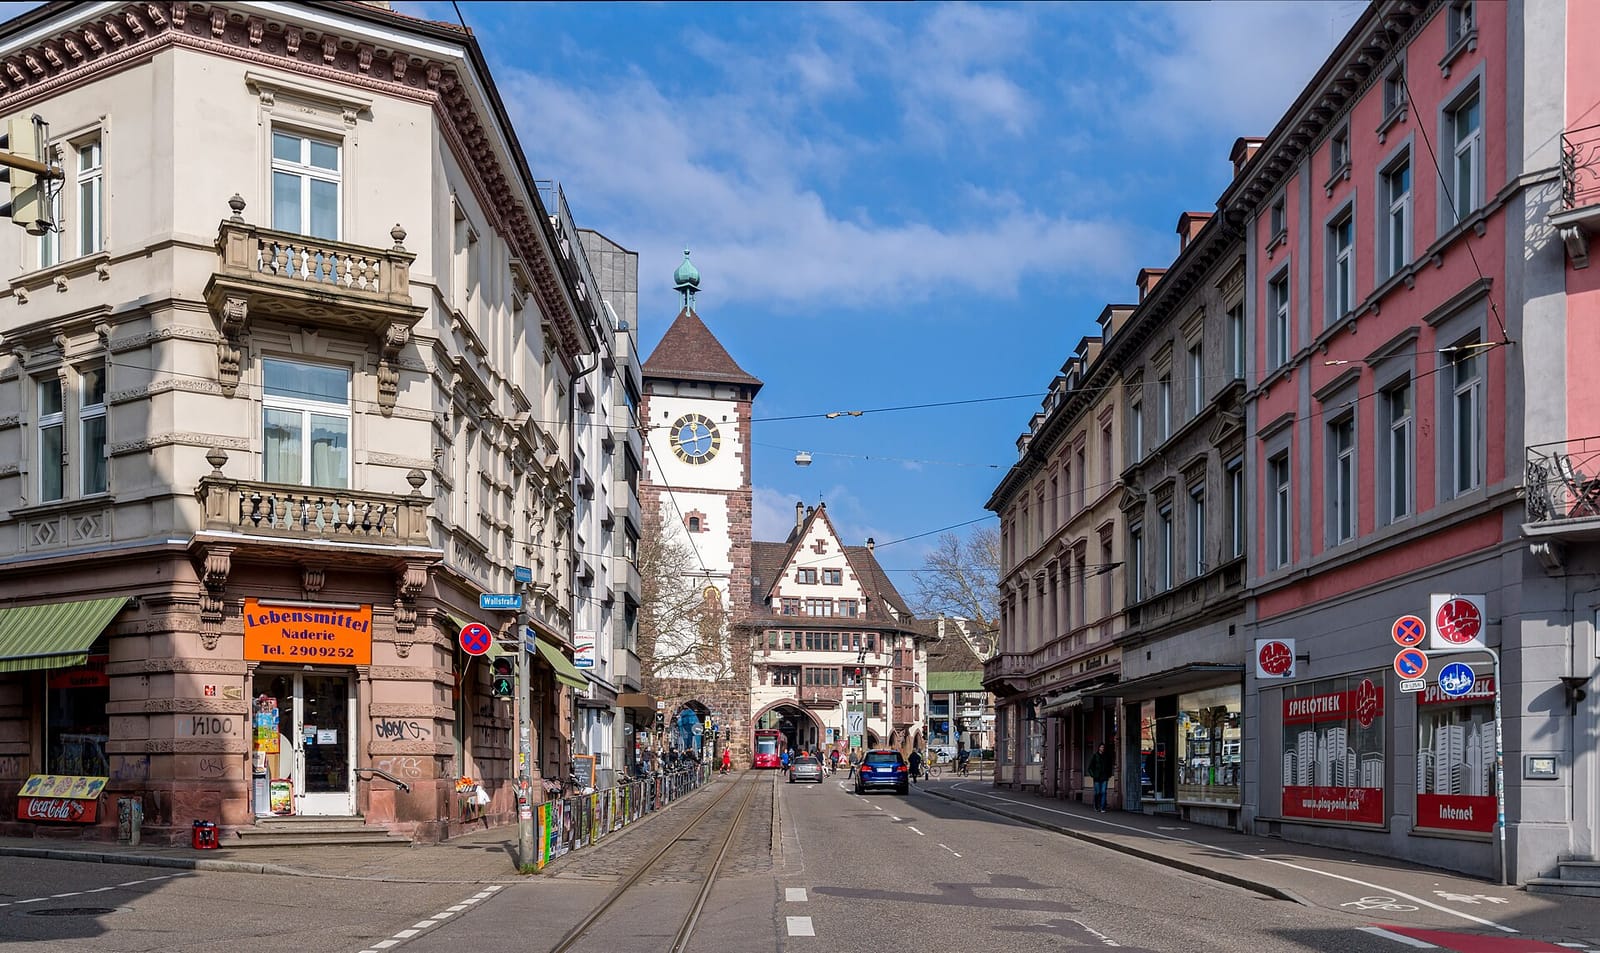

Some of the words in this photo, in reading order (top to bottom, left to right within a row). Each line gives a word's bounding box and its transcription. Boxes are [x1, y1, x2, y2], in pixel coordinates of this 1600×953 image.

[247, 610, 369, 633] Lebensmittel
[281, 628, 335, 640] Naderie
[262, 644, 285, 655] Tel.
[1289, 695, 1340, 716] SPIELOTHEK
[1302, 797, 1359, 812] www.play-point.net
[1439, 804, 1473, 821] Internet
